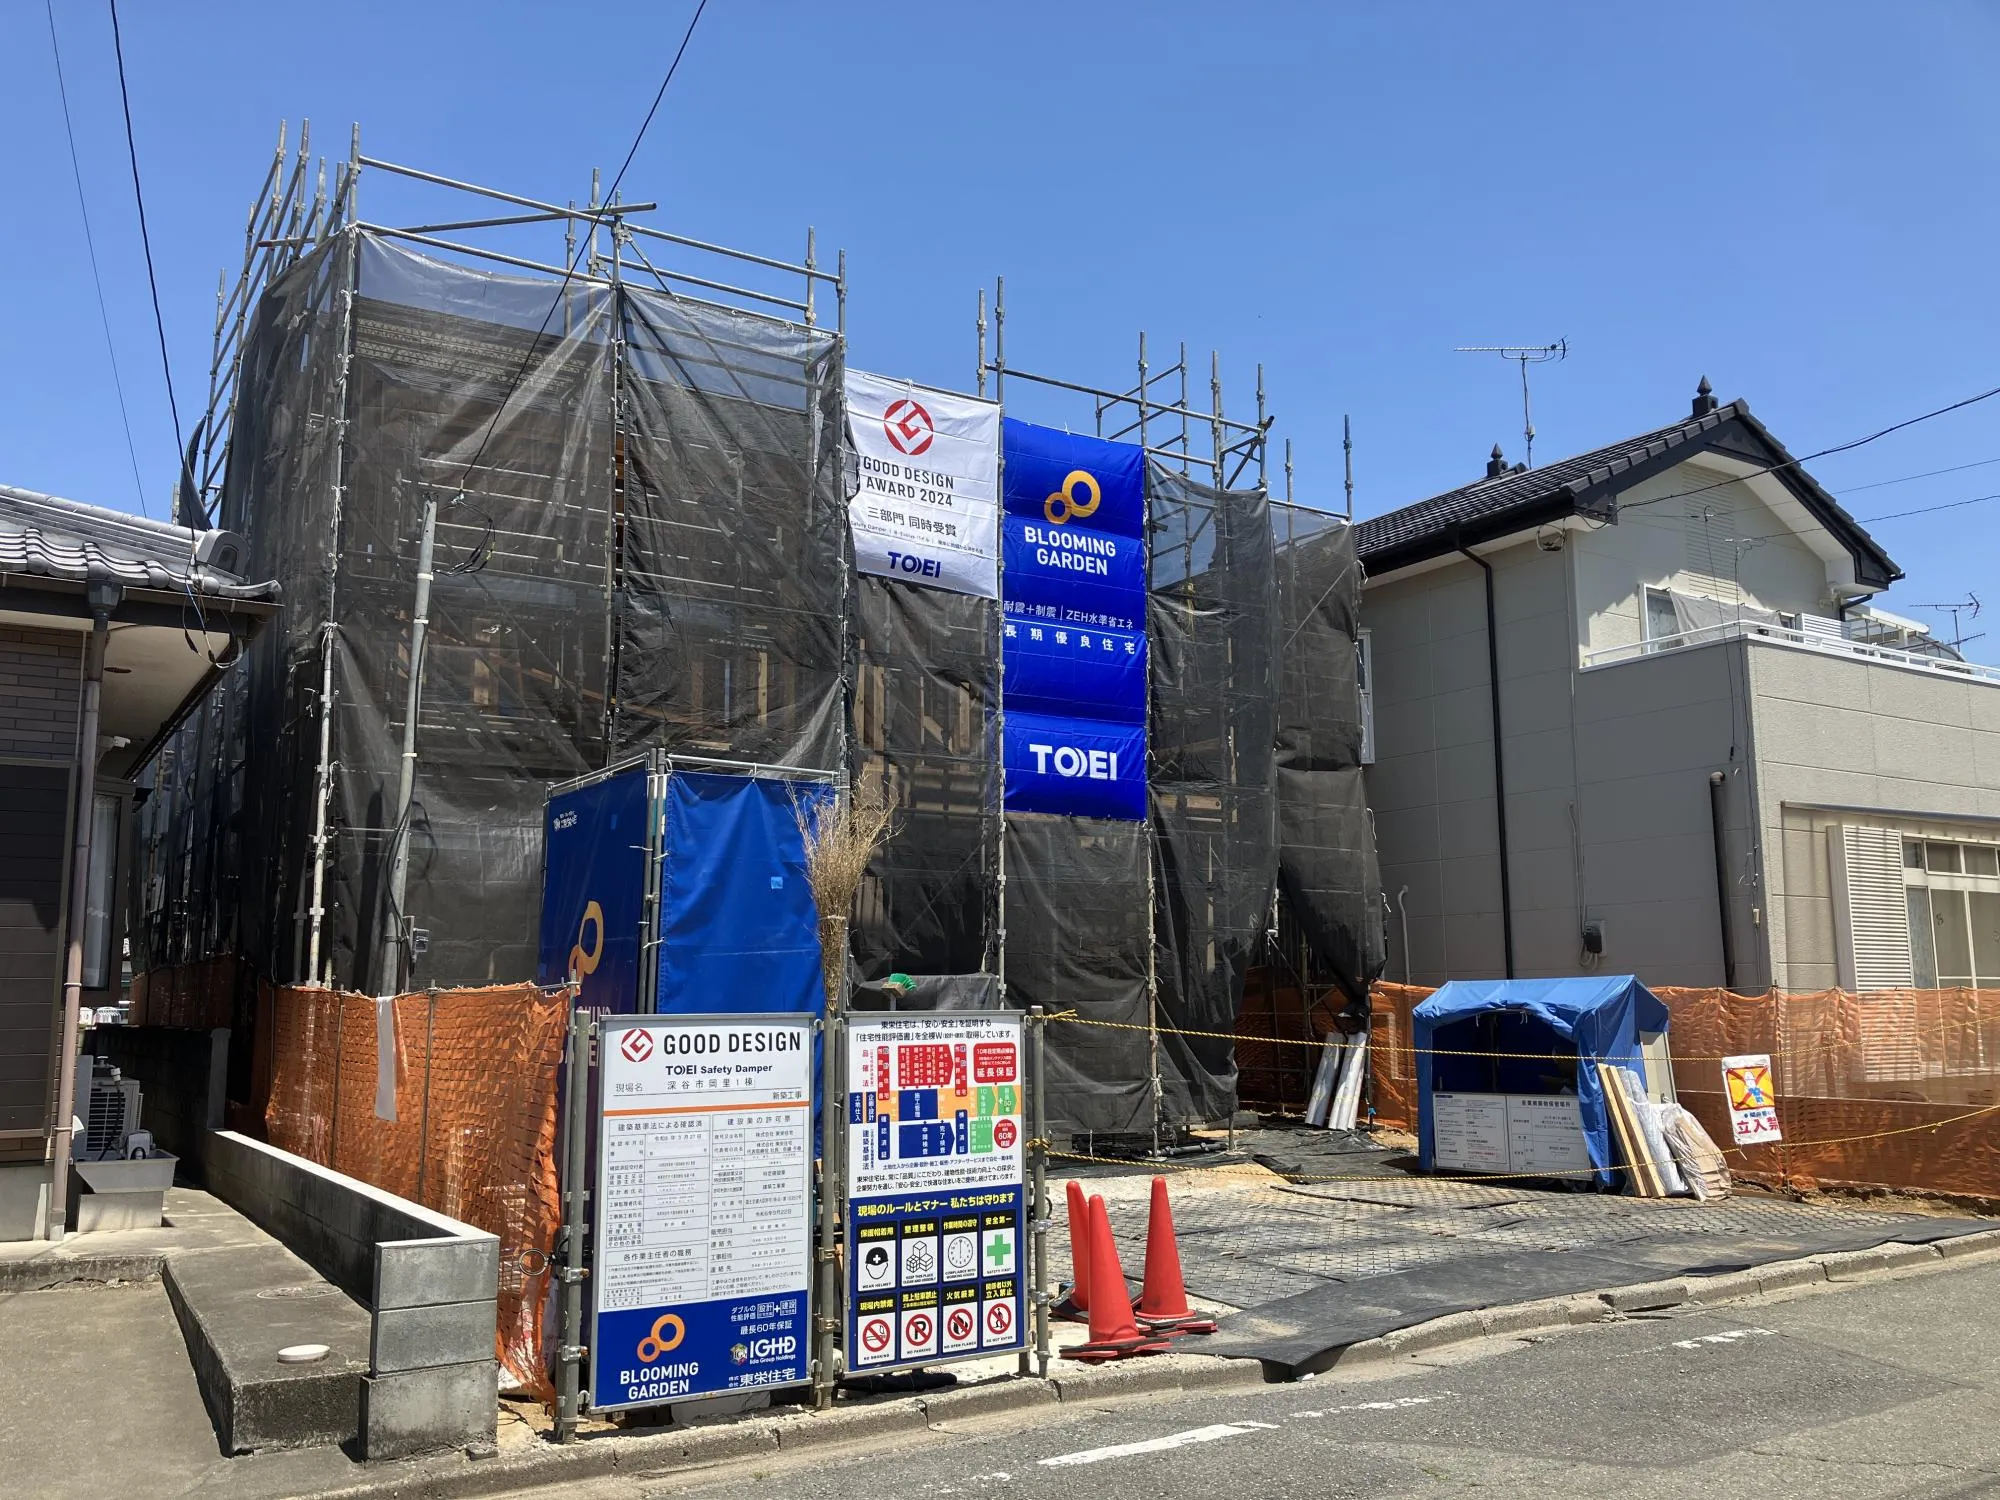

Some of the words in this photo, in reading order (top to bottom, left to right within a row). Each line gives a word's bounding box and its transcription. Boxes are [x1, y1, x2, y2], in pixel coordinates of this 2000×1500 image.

[863, 457, 899, 477] GOOD
[904, 466, 954, 490] DESIGN
[866, 477, 915, 499] AWARD
[920, 488, 953, 507] 2024
[867, 506, 905, 526] 三部門
[908, 513, 957, 537] 同時受賞
[1024, 527, 1117, 557] BLOOMING
[887, 551, 941, 578] TOEI
[1036, 548, 1108, 576] GARDEN
[1066, 609, 1134, 630] ZEH水準省エネ
[1004, 624, 1135, 655] 長期優良住宅
[1029, 743, 1118, 781] TOEI
[663, 1034, 721, 1055] GOOD
[728, 1031, 802, 1053] DESIGN
[665, 1065, 697, 1076] TOEI
[700, 1065, 732, 1076] Safety
[735, 1064, 773, 1075] Damper
[976, 1067, 1014, 1077] 延長保証
[615, 1082, 644, 1093] 現場名
[617, 1120, 704, 1132] 建築基準法による確認済
[727, 1115, 791, 1127] 建設業の許可票
[1736, 1116, 1780, 1135] 立入禁
[857, 1201, 948, 1218] 現場のルールとマナー
[950, 1192, 1015, 1207] 私たちは守ります
[860, 1226, 894, 1239] 保護帽着用
[904, 1222, 934, 1234] 整理整頓
[985, 1215, 1013, 1226] 安全第一
[623, 1248, 692, 1262] 各作業主任者の職務
[859, 1299, 894, 1311] 現場内禁煙
[902, 1291, 937, 1302] 路上駐車禁止
[946, 1289, 975, 1301] 火気厳禁
[985, 1288, 1013, 1299] 立入禁止
[730, 1313, 756, 1322] 性能評価
[731, 1305, 756, 1314] ダブルの
[740, 1320, 793, 1335] 最長60年保証
[749, 1335, 797, 1358] IGHD
[759, 1356, 775, 1364] Group
[775, 1354, 796, 1362] Holdings
[620, 1361, 699, 1385] BLOOMING
[740, 1367, 796, 1387] 東栄住宅
[628, 1379, 690, 1400] GARDEN
